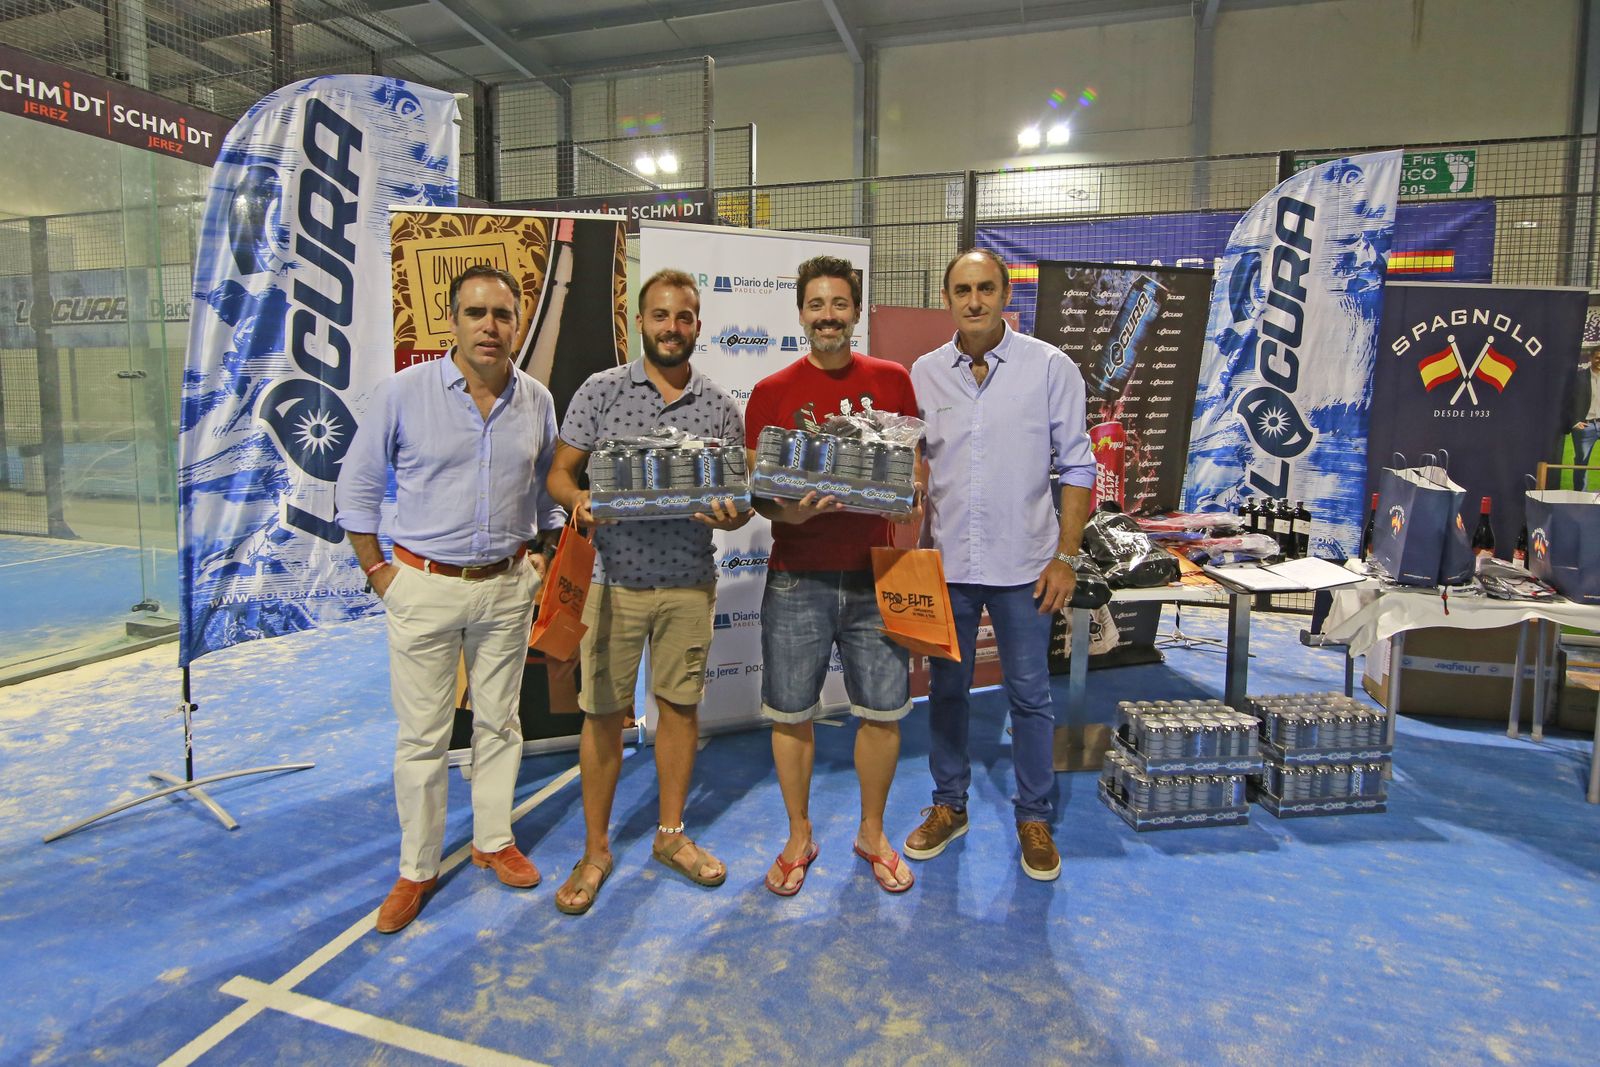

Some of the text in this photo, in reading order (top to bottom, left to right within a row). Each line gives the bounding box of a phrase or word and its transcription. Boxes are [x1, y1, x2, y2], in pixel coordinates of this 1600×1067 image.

[23, 100, 68, 122] JEREZ
[148, 135, 183, 154] JEREZ
[1413, 155, 1436, 166] PIE
[734, 276, 797, 291] Diario de Jerez
[1391, 308, 1543, 357] SPAGNOLO
[440, 338, 455, 347] BY
[719, 334, 769, 348] LOCURA
[1433, 409, 1491, 418] DESDE 1933
[721, 557, 769, 569] LOCURA
[732, 611, 760, 622] Diario
[717, 667, 738, 680] Jerez
